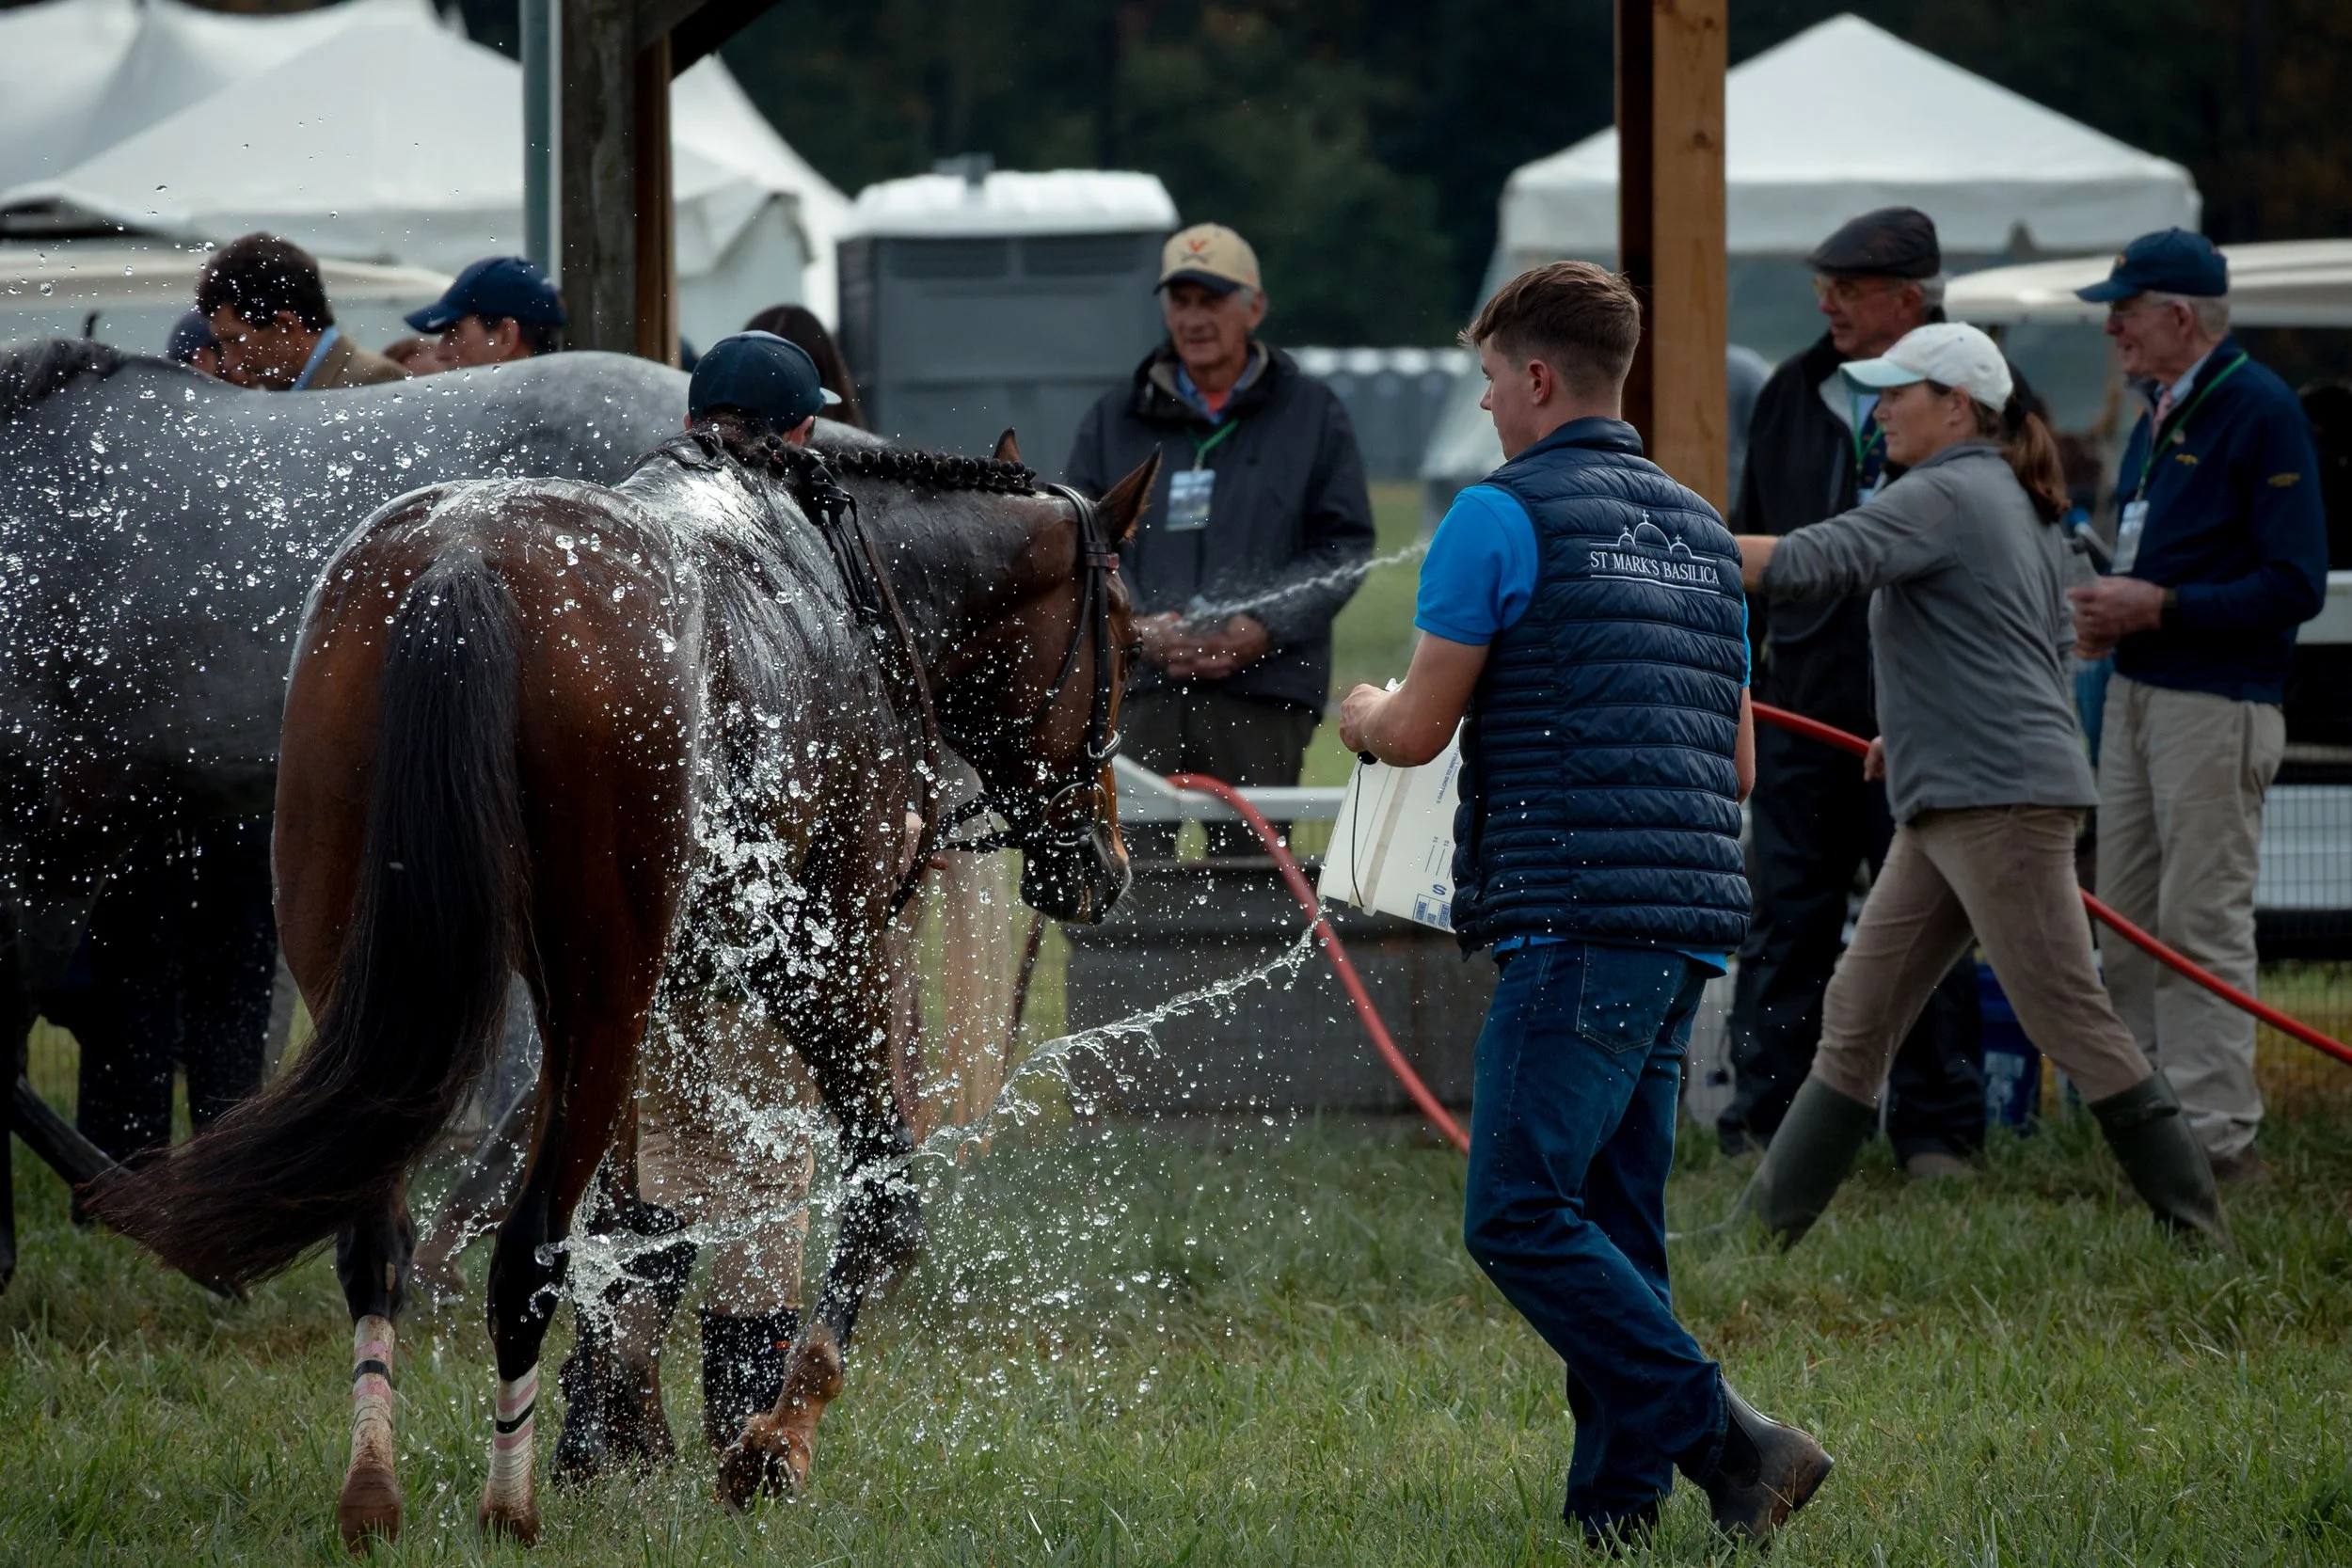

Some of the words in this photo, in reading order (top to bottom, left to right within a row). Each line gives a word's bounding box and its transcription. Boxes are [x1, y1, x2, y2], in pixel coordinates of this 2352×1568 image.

[1590, 551, 1608, 569] ST
[1613, 553, 1660, 576] MARK'S
[1662, 561, 1720, 585] BASILICA
[1438, 776, 1450, 800] GALLONS
